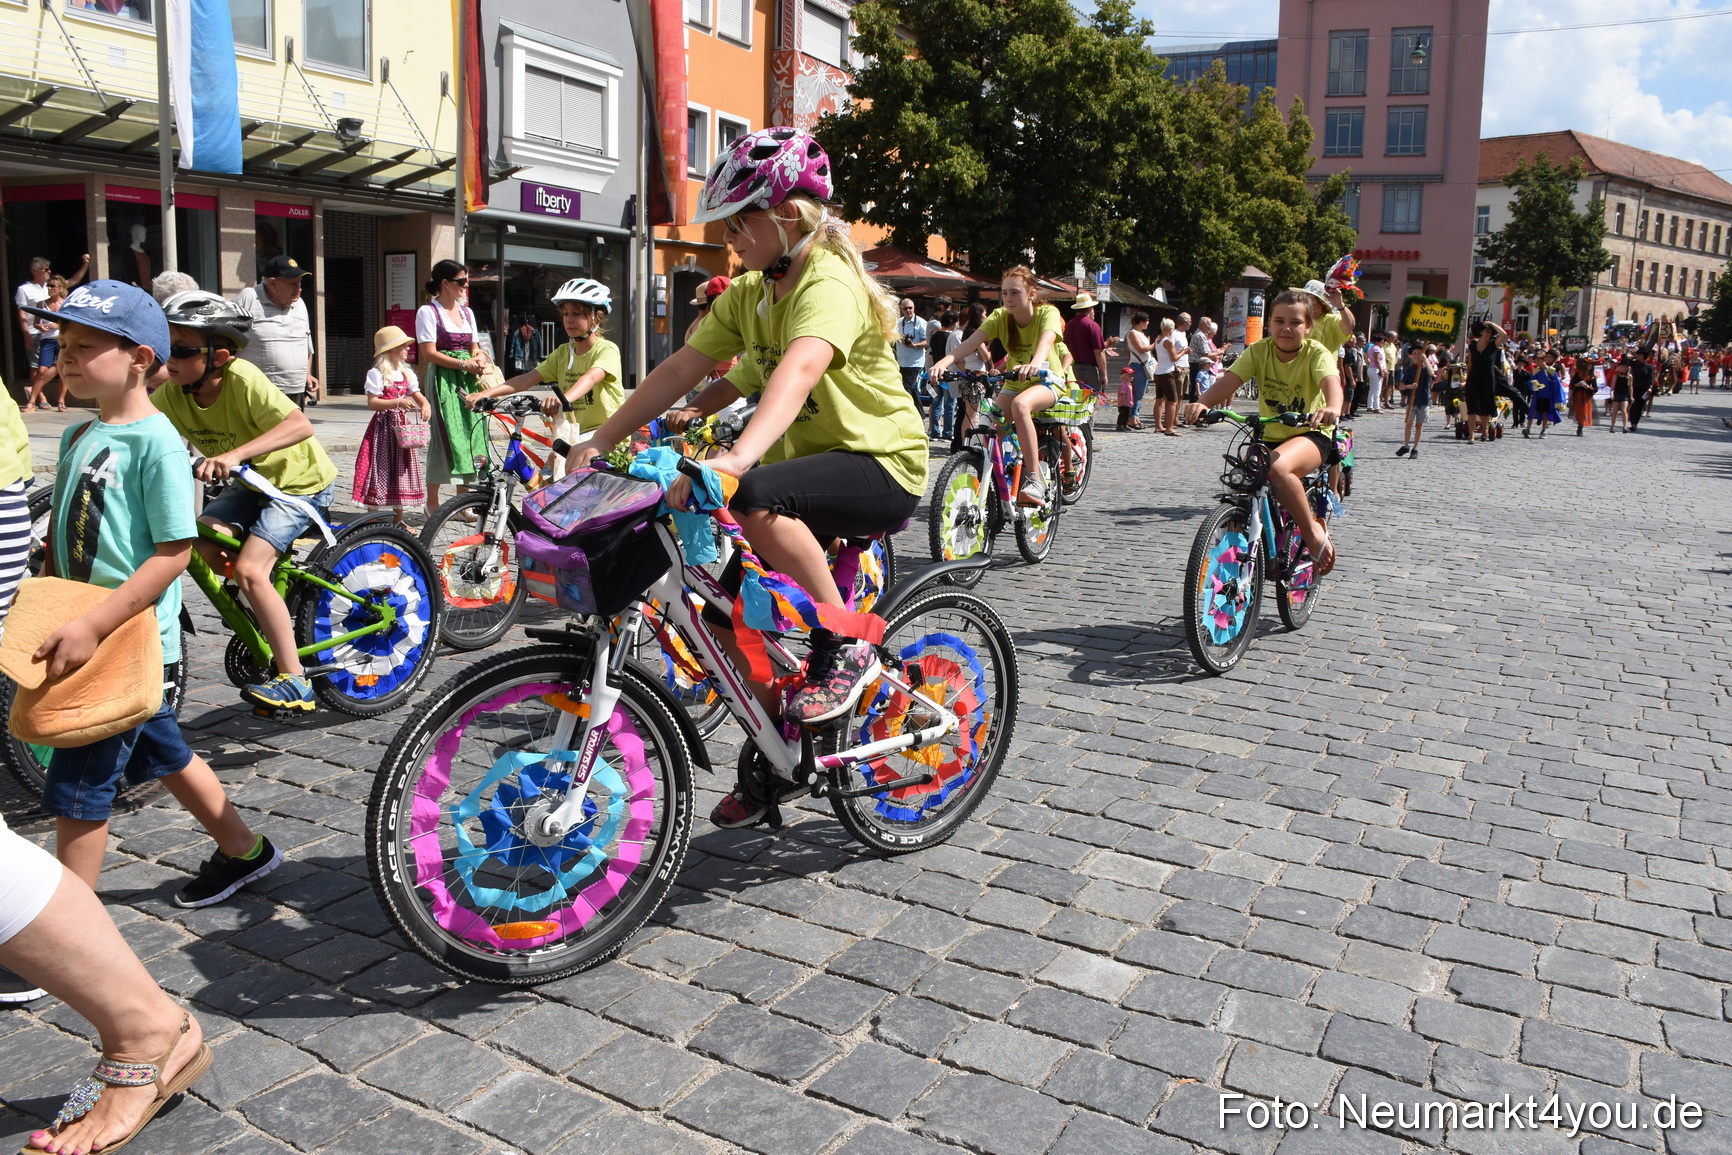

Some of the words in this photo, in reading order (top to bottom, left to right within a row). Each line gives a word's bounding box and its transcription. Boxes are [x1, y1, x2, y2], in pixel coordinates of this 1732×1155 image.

[289, 207, 309, 216] ADLER
[536, 187, 571, 213] liberty
[1354, 246, 1421, 260] parkasse
[1419, 305, 1448, 317] Schule
[1411, 317, 1450, 331] Wolfstein
[75, 489, 92, 534] Angeles
[73, 536, 84, 563] Los
[171, 686, 181, 711] BLAC
[398, 730, 432, 789] PACE
[582, 729, 600, 766] SUNTOUR
[388, 799, 398, 831] OF
[880, 833, 896, 843] OF
[899, 834, 924, 844] ACE
[387, 841, 402, 883] ACE
